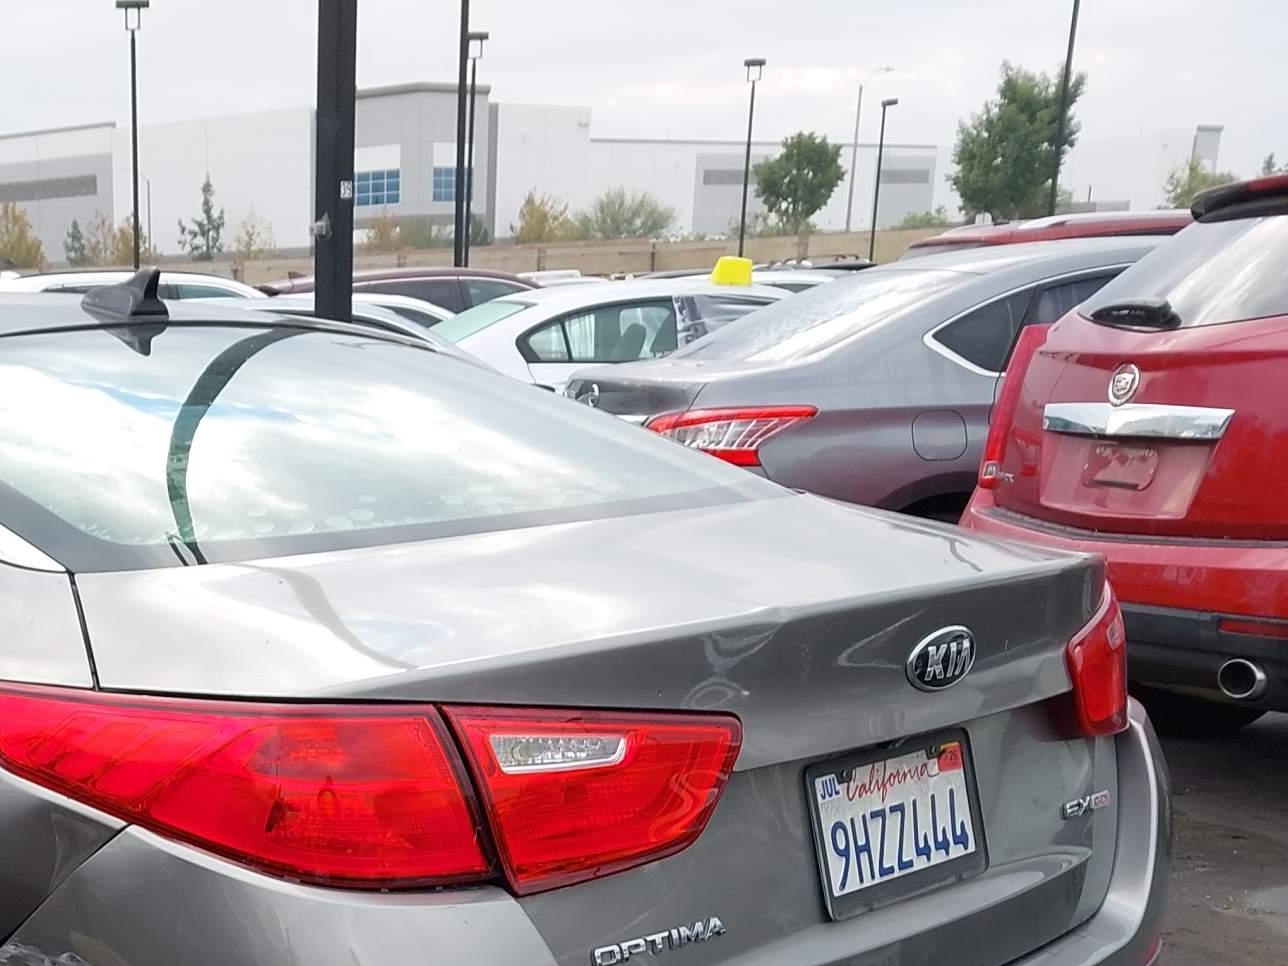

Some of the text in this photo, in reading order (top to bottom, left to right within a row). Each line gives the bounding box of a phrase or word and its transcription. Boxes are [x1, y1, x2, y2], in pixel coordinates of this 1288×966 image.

[924, 639, 971, 681] KIA
[819, 778, 841, 801] JUL
[845, 760, 940, 804] California
[830, 786, 970, 892] 9HZZ444
